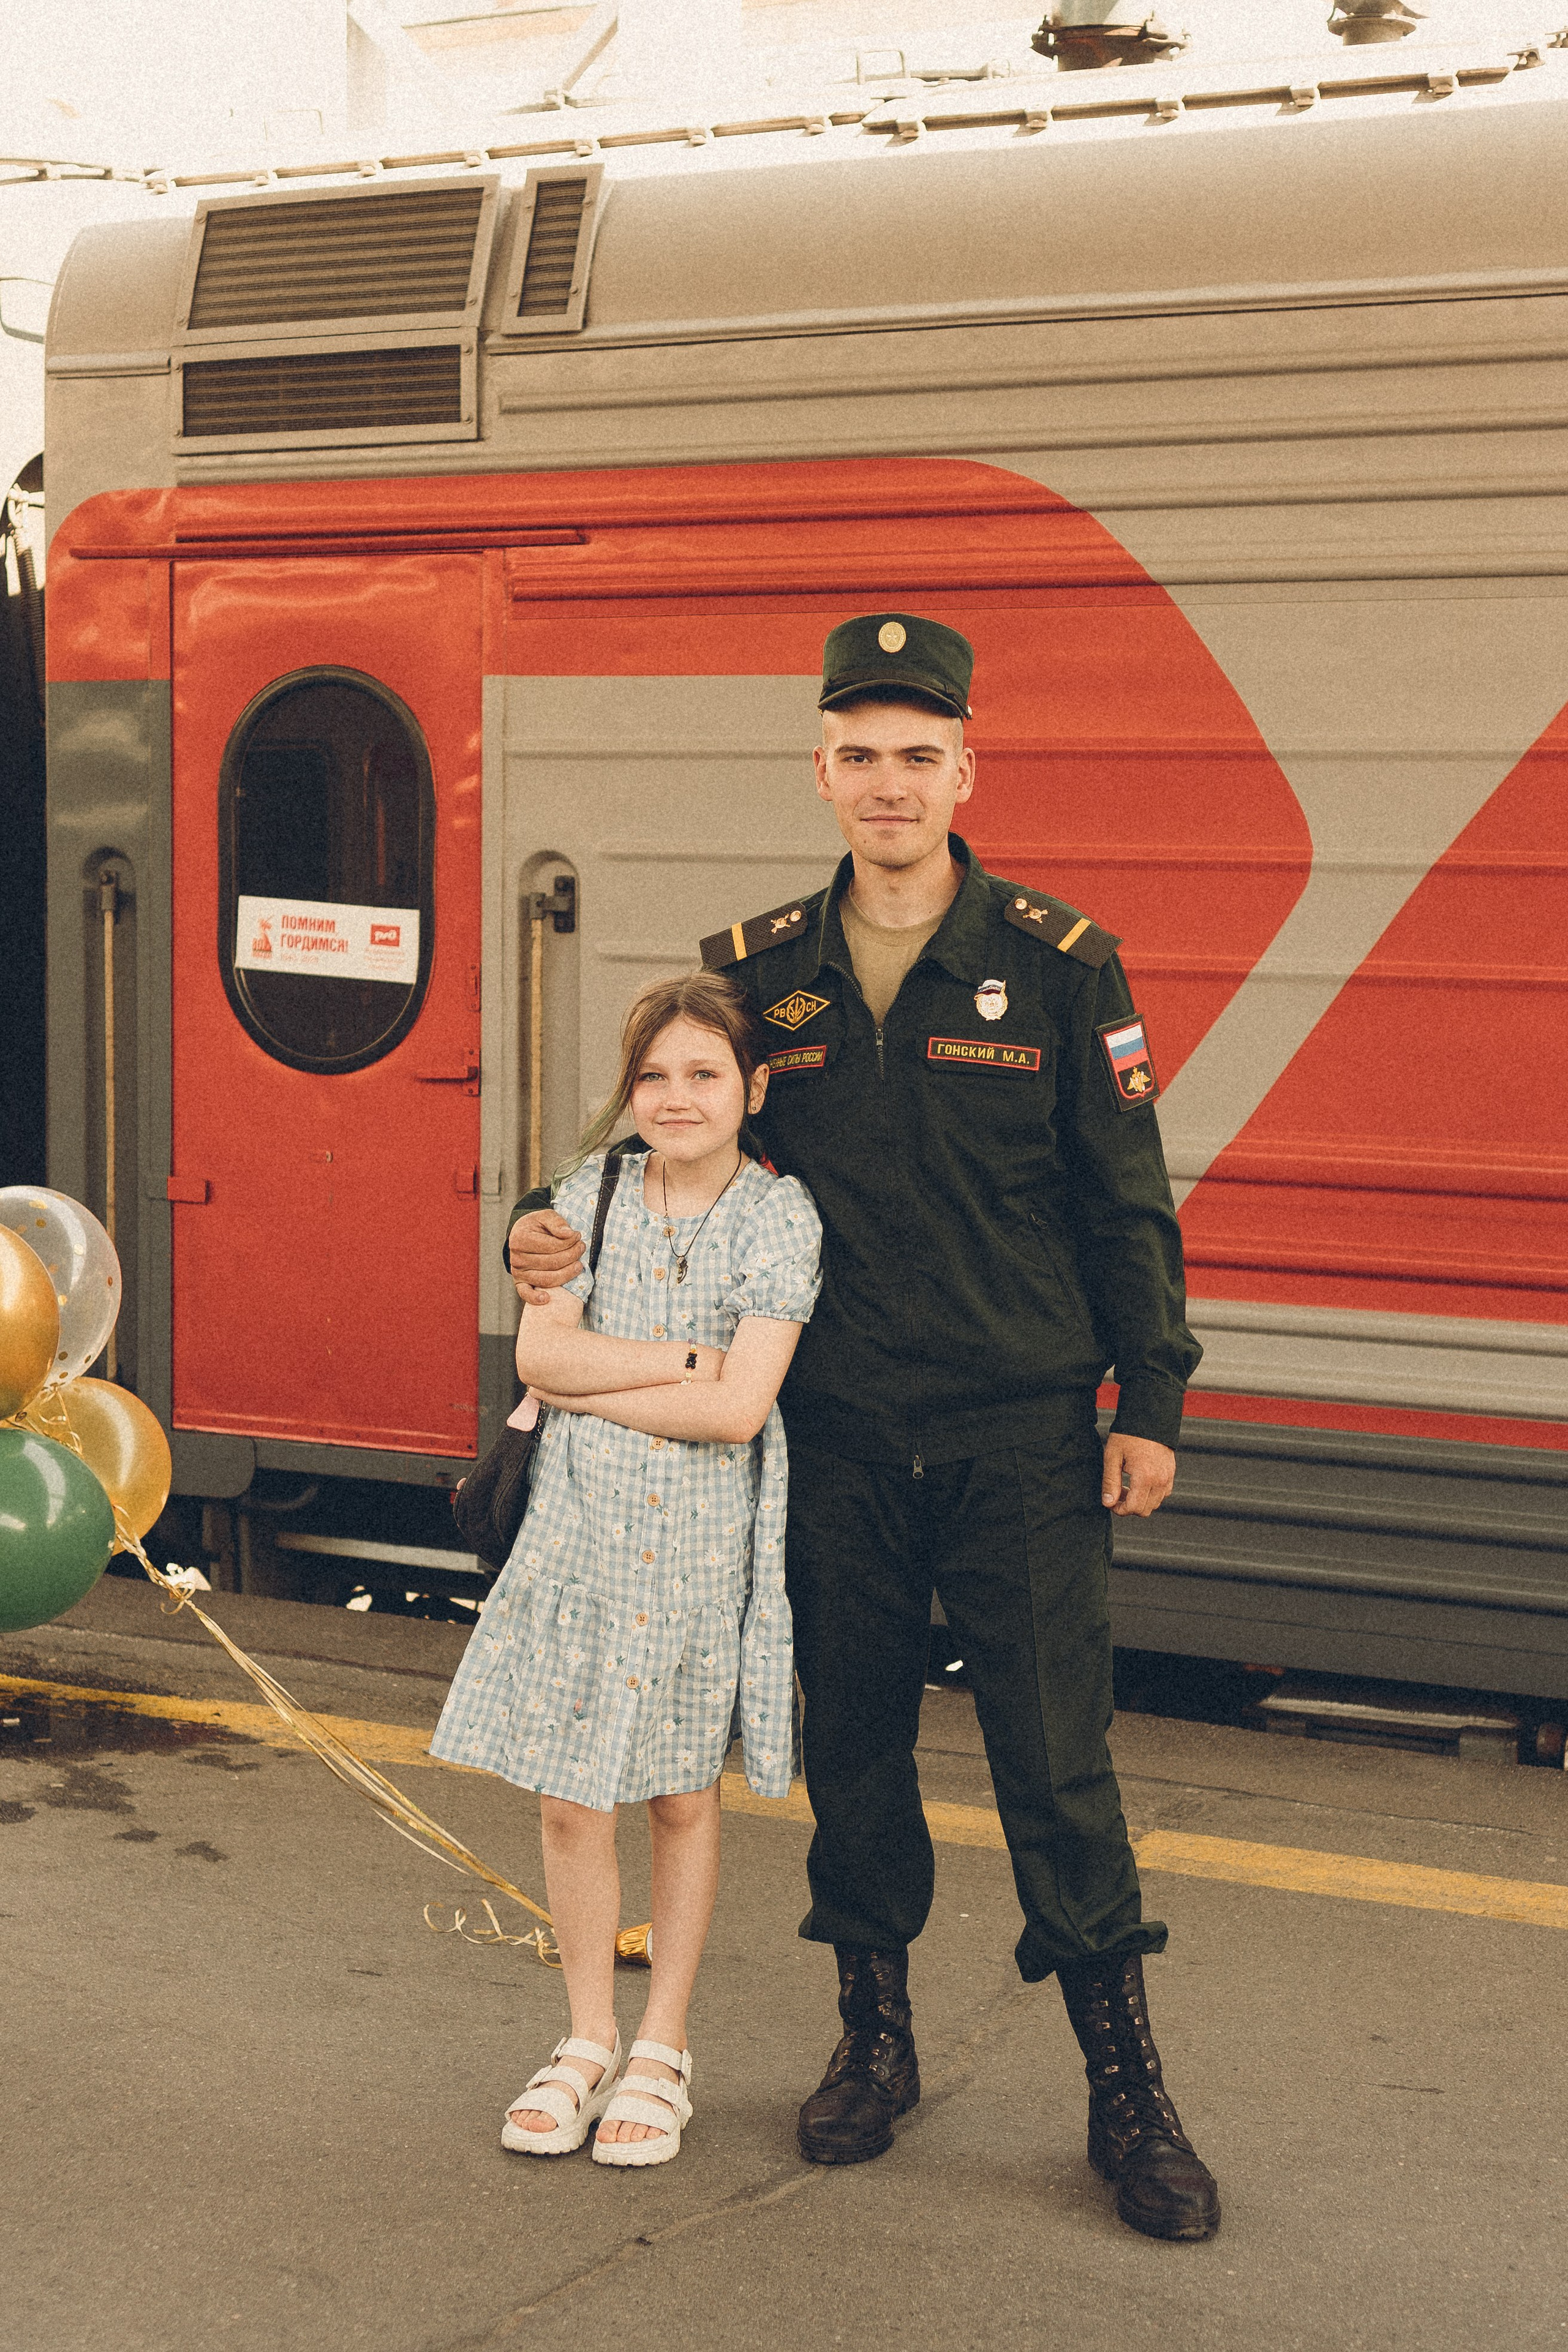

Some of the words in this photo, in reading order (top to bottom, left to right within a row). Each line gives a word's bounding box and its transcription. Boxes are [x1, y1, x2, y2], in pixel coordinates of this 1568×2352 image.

[280, 933, 349, 953] ГОРДИМСЯ!
[802, 1051, 823, 1063] РОССИИ
[937, 1044, 995, 1060] ГОНСКИЙ
[1003, 1050, 1030, 1065] М.А.
